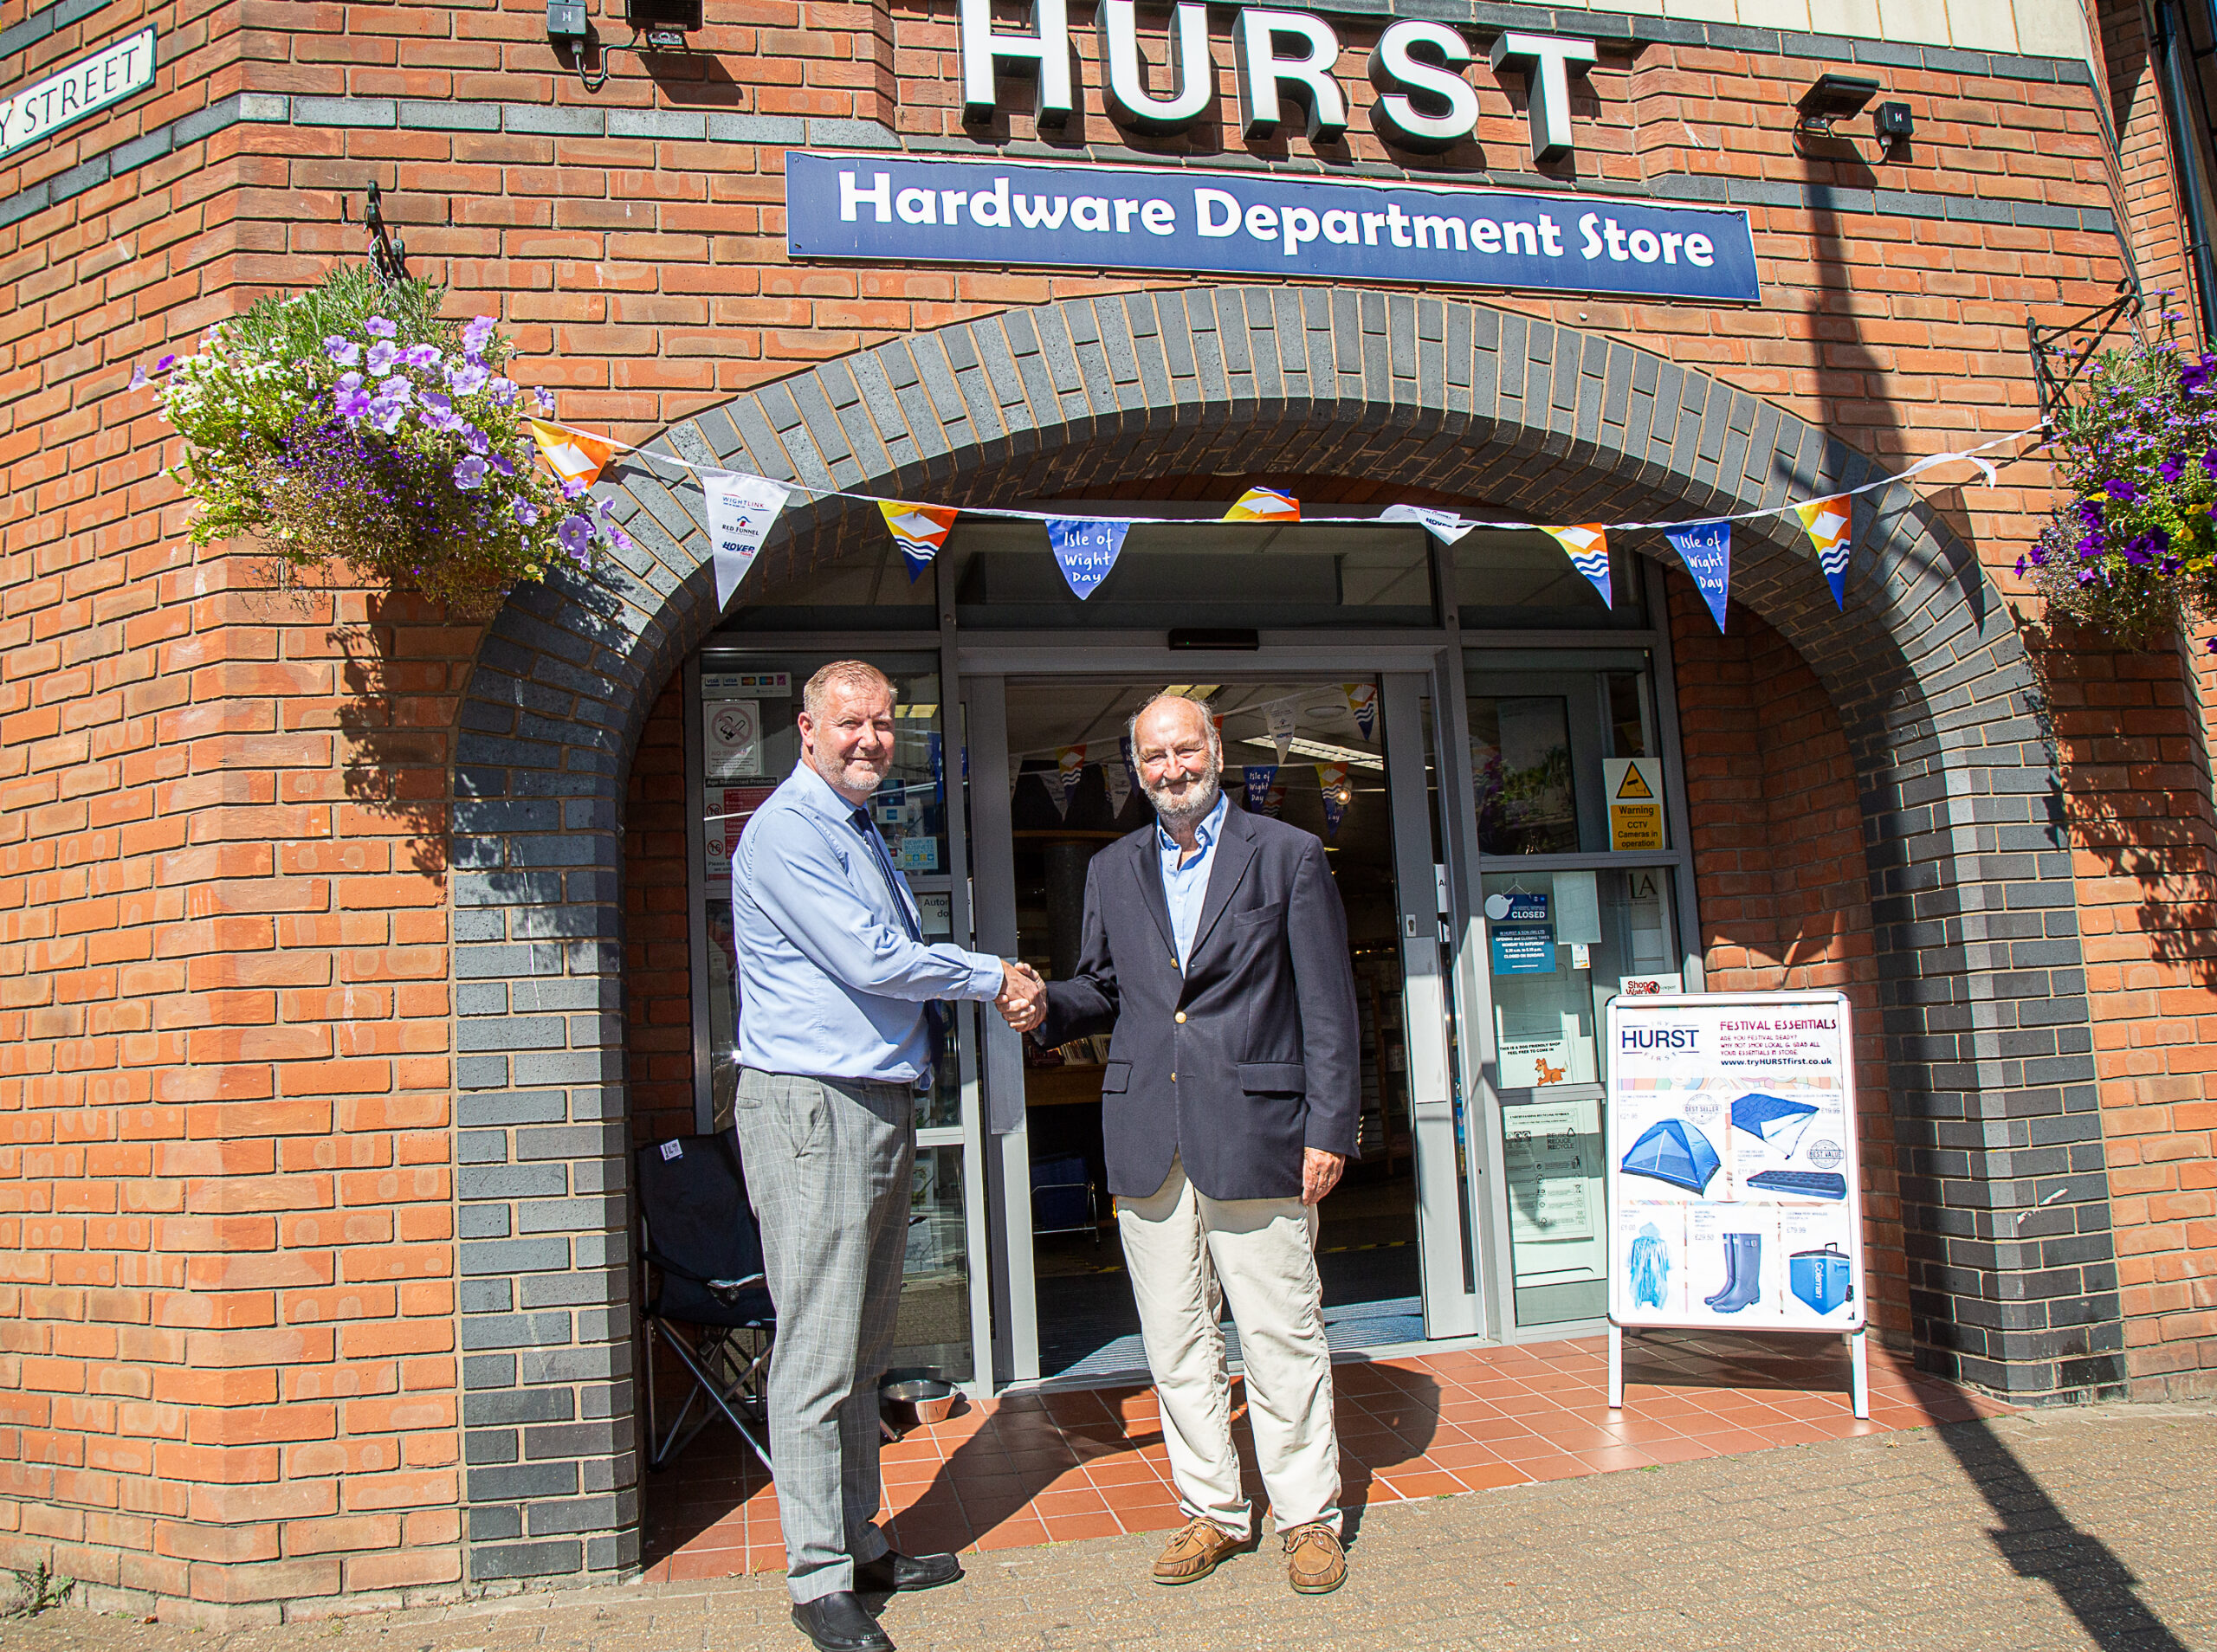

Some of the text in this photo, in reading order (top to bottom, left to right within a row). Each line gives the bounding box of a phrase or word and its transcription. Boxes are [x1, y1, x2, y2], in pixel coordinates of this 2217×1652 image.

[961, 0, 1597, 160] HURST
[24, 46, 139, 133] STREET
[838, 170, 1715, 268] Hardware Department Store
[722, 496, 765, 508] WIGHTLINK
[735, 526, 759, 536] FUNNEL
[1063, 529, 1115, 551] Isle of
[1679, 531, 1721, 553] Isle of
[722, 541, 755, 552] HOVER
[1063, 552, 1112, 571] Wight
[1686, 553, 1724, 572] Wight
[1072, 571, 1102, 584] Day
[1699, 575, 1724, 594] Day
[1249, 771, 1270, 783] Isle of
[1249, 782, 1269, 794] Wight
[1251, 794, 1264, 804] Day
[1618, 805, 1655, 816] Warning
[1621, 839, 1656, 848] operation
[1627, 980, 1648, 989] Shop
[1720, 1019, 1837, 1030] FESTIVAL ESSENTIALS
[1622, 1029, 1700, 1049] HURST
[1721, 1057, 1832, 1067] www.tryHURSTfirst.co.uk
[1815, 1262, 1824, 1299] Coleman
